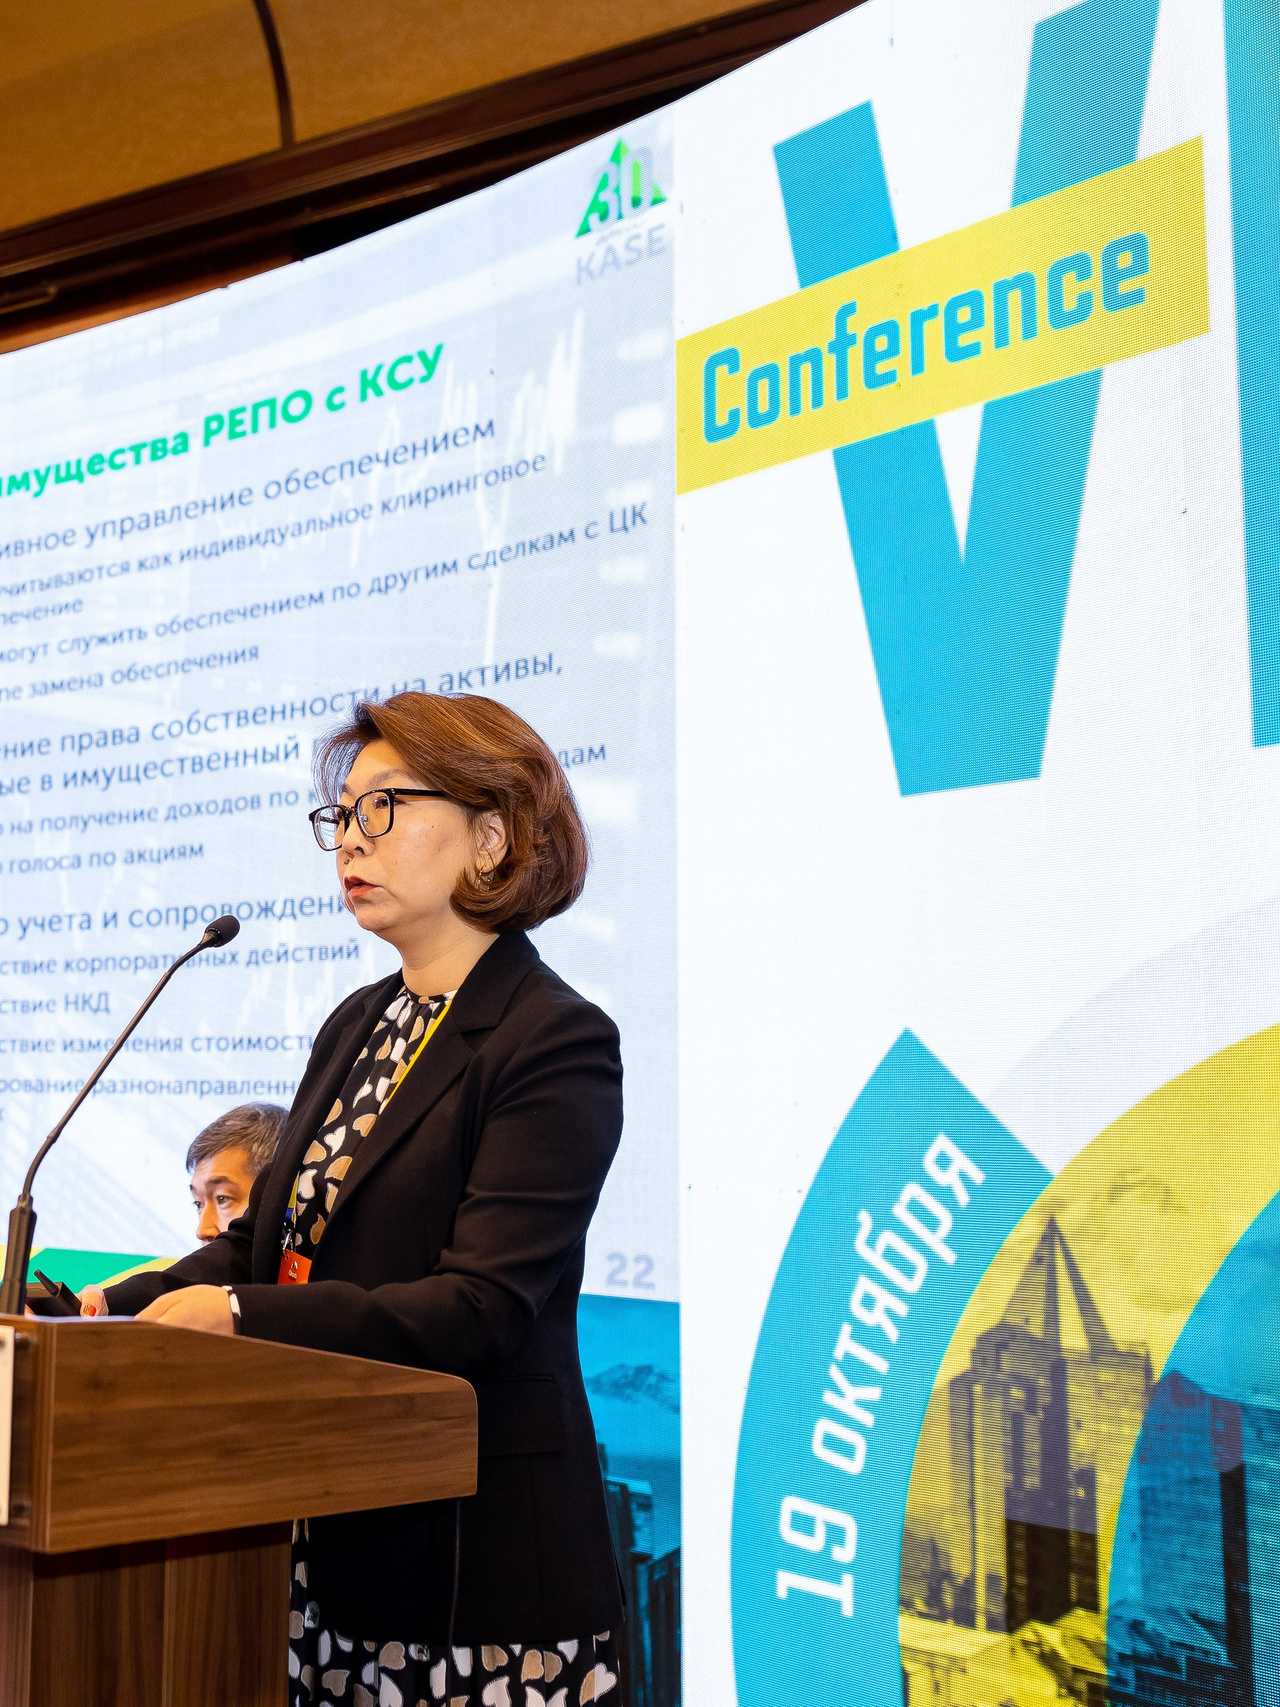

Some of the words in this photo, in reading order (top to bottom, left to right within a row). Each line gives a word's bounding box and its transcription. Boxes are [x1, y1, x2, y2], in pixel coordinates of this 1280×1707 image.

[576, 223, 667, 286] KASE
[703, 232, 1149, 444] Conference
[203, 390, 313, 447] РЕПО
[326, 386, 346, 412] с
[359, 343, 444, 403] КСУ
[85, 485, 254, 548] управление
[263, 419, 496, 501] обеспечением
[138, 552, 172, 573] как
[180, 501, 373, 562] индивидуальное
[381, 453, 546, 516] клиринговое
[57, 628, 148, 655] служить
[155, 589, 325, 638] обеспечением
[332, 582, 360, 602] по
[367, 557, 459, 596] другим
[467, 528, 576, 571] сделкам
[584, 521, 599, 540] с
[609, 502, 648, 534] ЦК
[28, 671, 104, 698] замена
[111, 645, 260, 686] обеспечения
[60, 725, 141, 756] права
[151, 686, 380, 742] собственности
[439, 652, 563, 694] активы,
[40, 773, 53, 792] в
[63, 735, 300, 791] имущественный
[11, 818, 33, 835] на
[41, 805, 159, 834] получение
[165, 793, 261, 821] доходов
[269, 789, 299, 807] по
[9, 852, 82, 874] голоса
[89, 849, 116, 868] по
[123, 842, 204, 866] акциям
[17, 912, 92, 940] учета
[103, 912, 118, 929] и
[128, 896, 346, 930] сопровождени
[246, 938, 360, 967] действий
[64, 992, 110, 1015] НКД
[606, 1252, 656, 1290] 22
[812, 1132, 986, 1475] октября
[776, 1495, 859, 1617] 19
